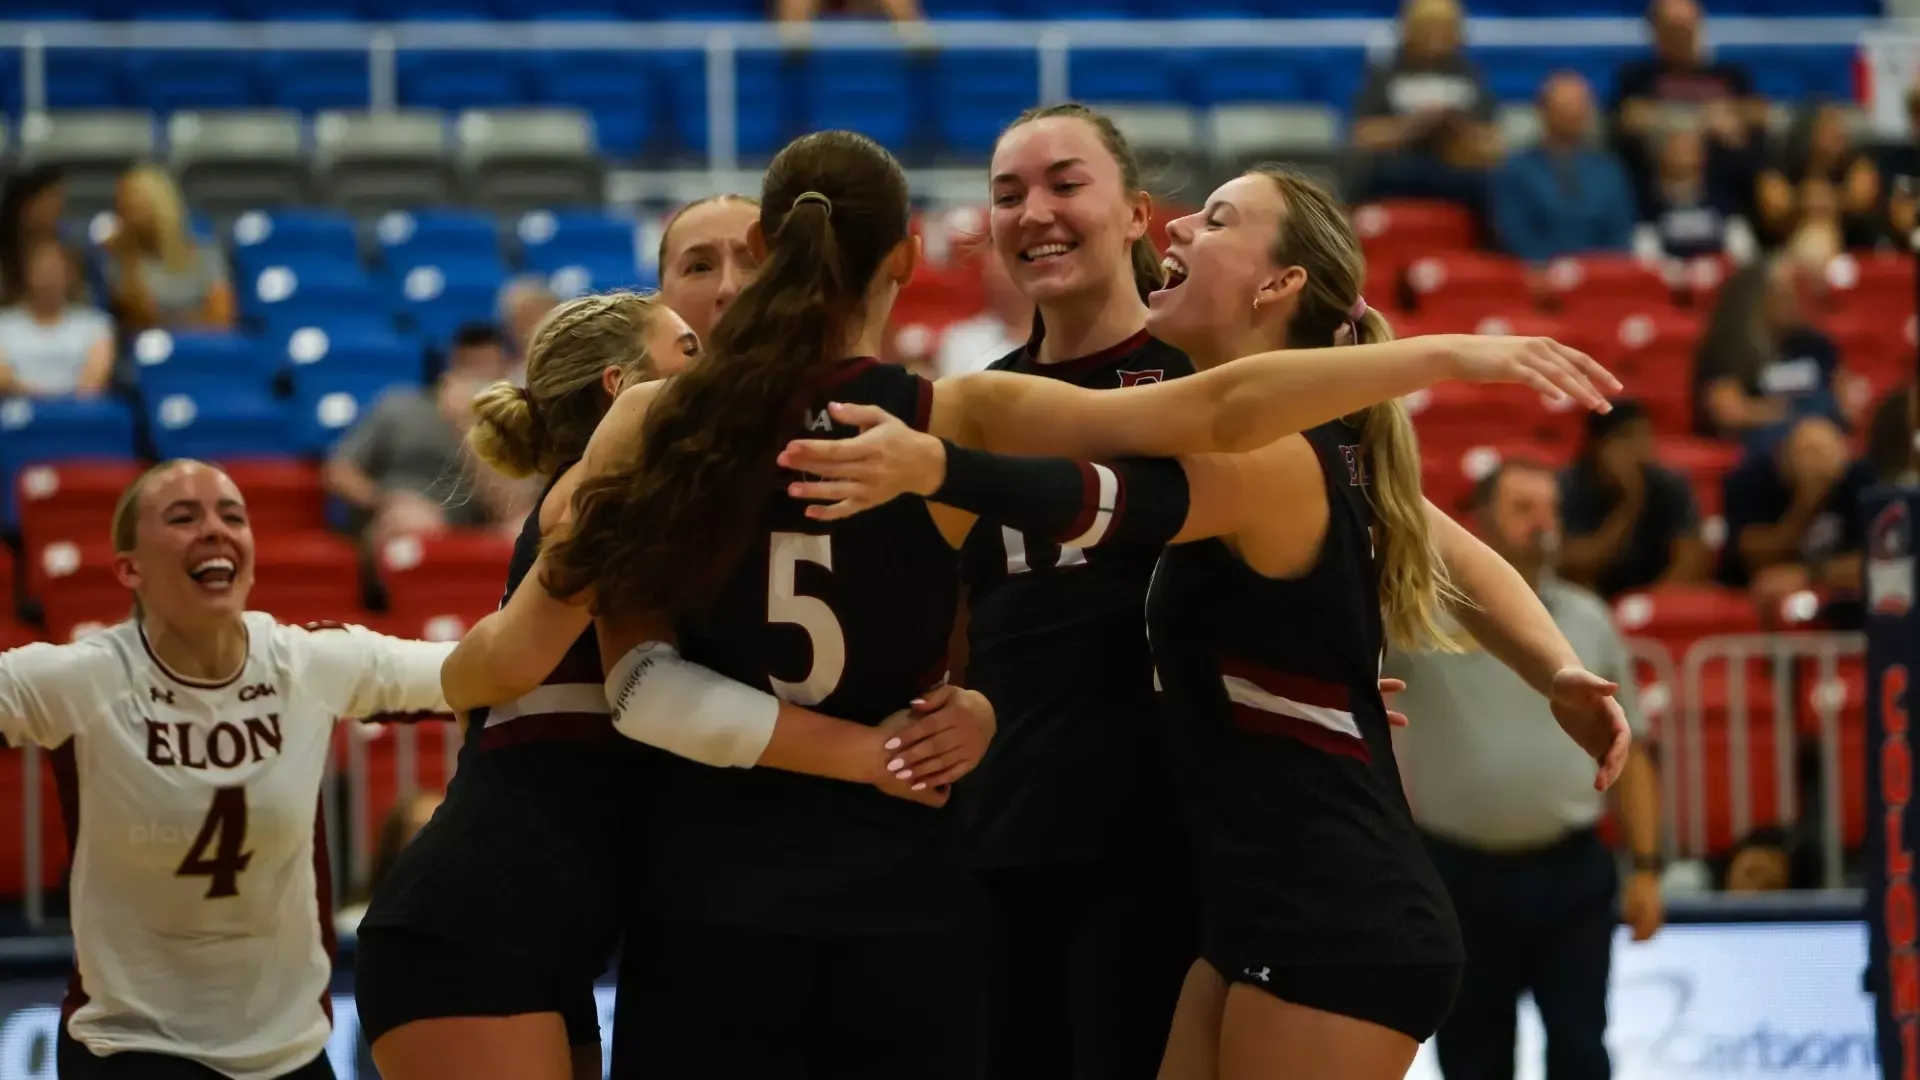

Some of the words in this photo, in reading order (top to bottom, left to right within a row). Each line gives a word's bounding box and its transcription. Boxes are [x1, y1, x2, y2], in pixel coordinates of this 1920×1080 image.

[767, 531, 845, 706] 5
[144, 713, 282, 769] ELON
[174, 785, 254, 898] 4
